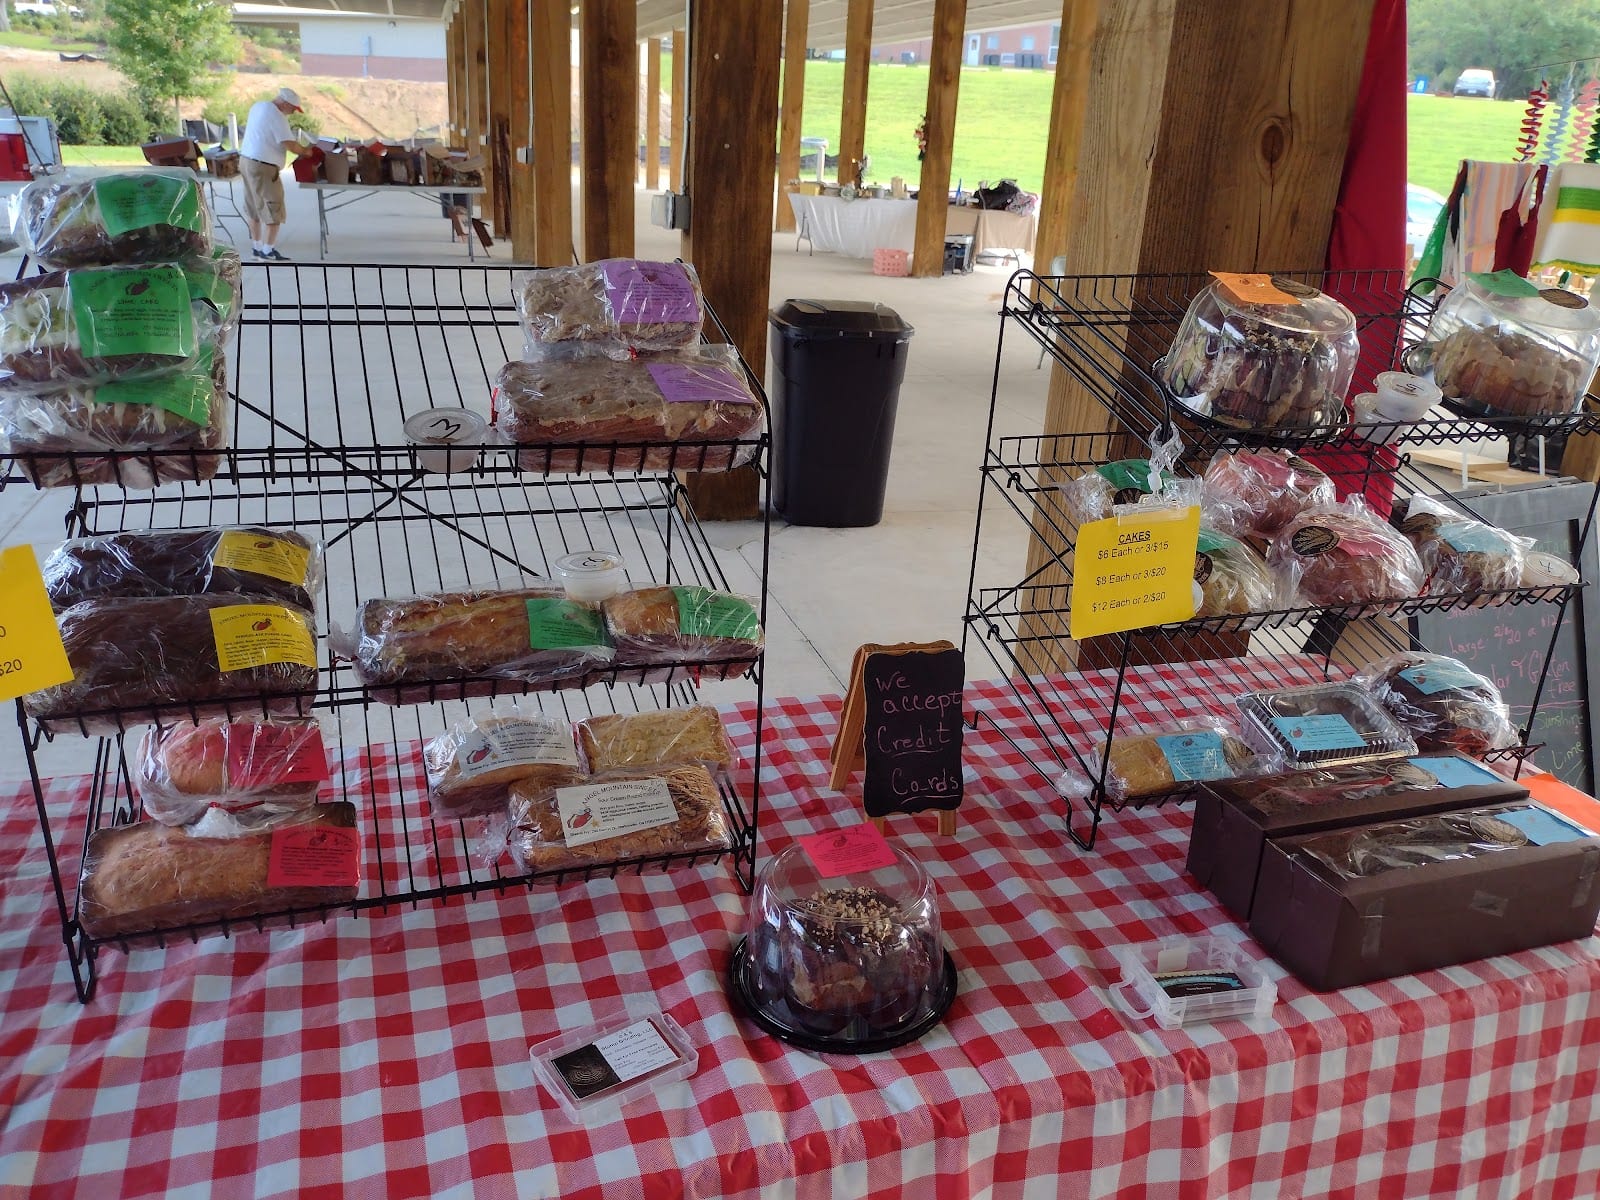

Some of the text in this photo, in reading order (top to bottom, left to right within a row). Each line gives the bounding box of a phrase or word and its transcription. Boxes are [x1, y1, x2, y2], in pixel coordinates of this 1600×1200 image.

[1118, 531, 1151, 545] CAKES
[1098, 541, 1169, 560] $6 Each or 3/$15
[1095, 567, 1167, 586] $8 Each or 3/$20
[1091, 592, 1166, 613] $12 Each or 2/$20
[1449, 636, 1487, 660] Large
[883, 690, 963, 718] accept
[877, 721, 951, 754] Credit
[601, 784, 633, 793] MOUNTAIN
[892, 768, 959, 796] Cards
